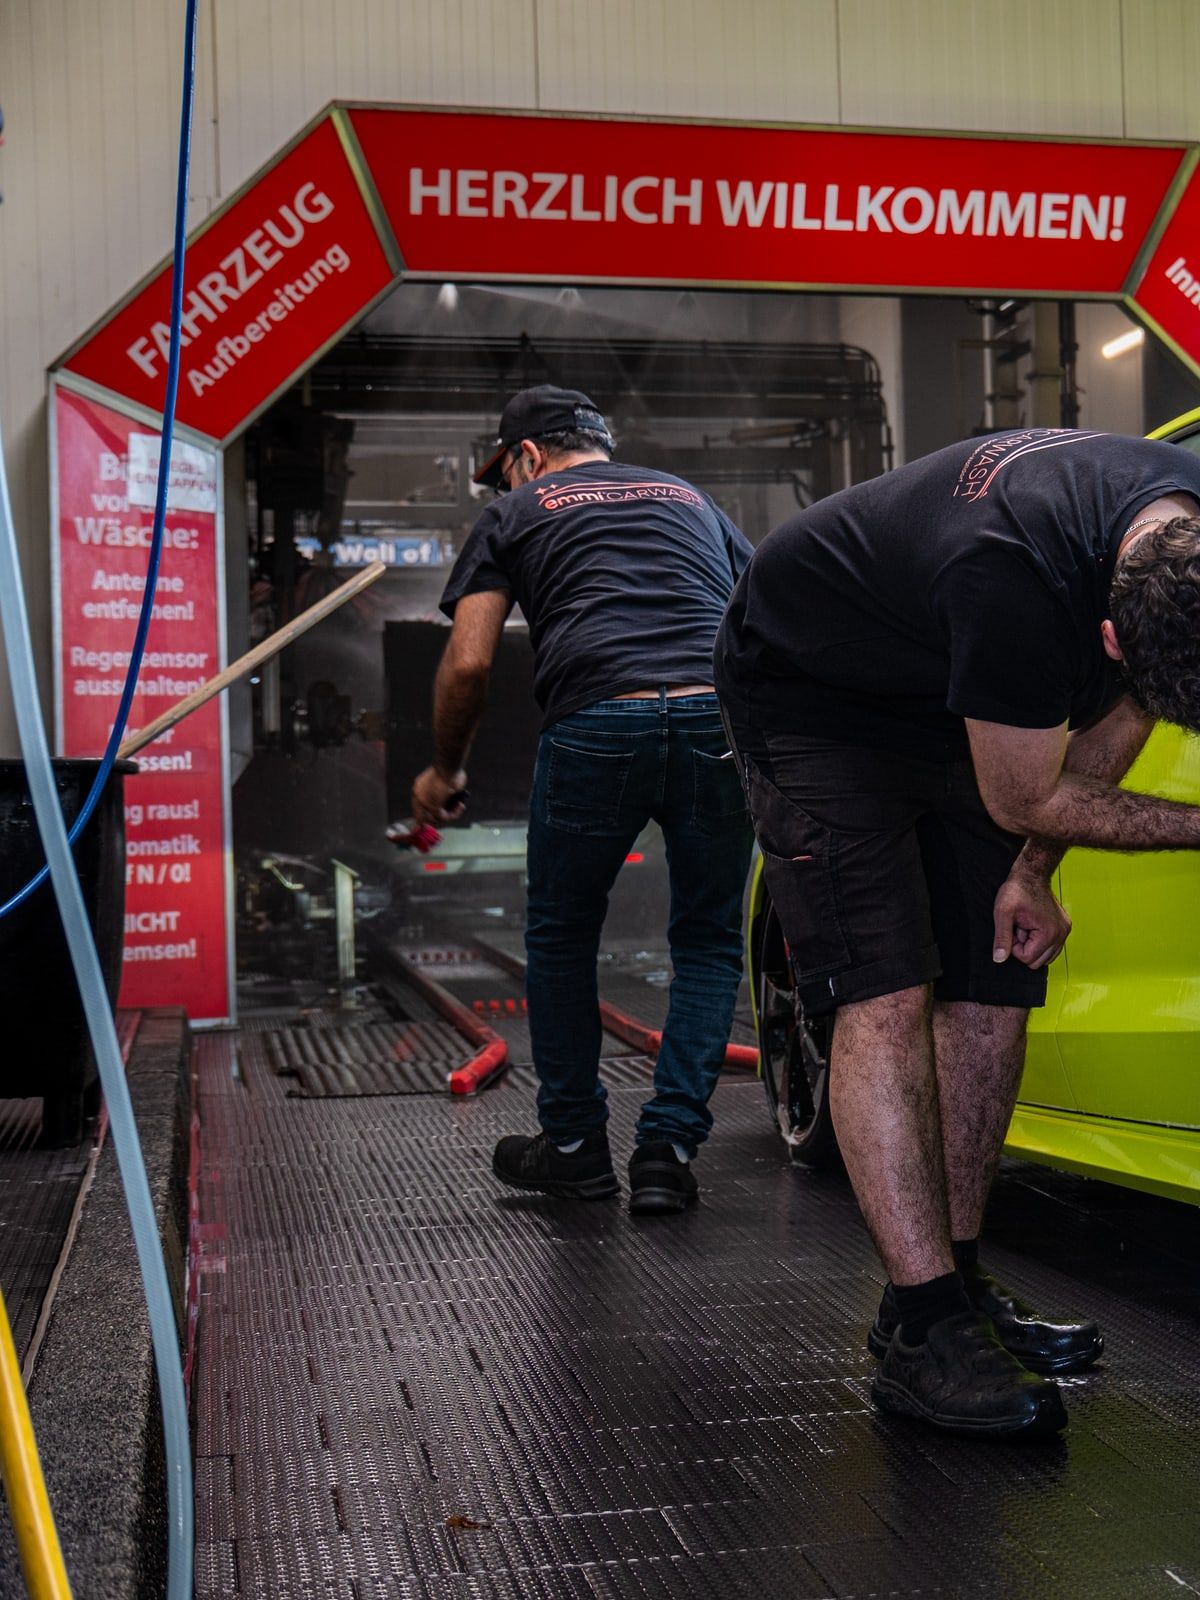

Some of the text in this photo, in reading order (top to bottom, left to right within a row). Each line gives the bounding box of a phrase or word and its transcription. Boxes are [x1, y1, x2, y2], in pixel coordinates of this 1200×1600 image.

[409, 167, 1127, 242] HERZLICH WILLKOMMEN!
[126, 181, 335, 379] FAHRZEUG
[186, 243, 351, 398] Aufbereitung
[543, 490, 604, 510] emmi
[606, 487, 704, 507] CARWASH
[91, 569, 184, 592] Antene
[82, 598, 195, 621] entfenen!
[147, 799, 200, 821] raus!
[125, 833, 201, 857] omatik
[122, 937, 198, 962] emsen!
